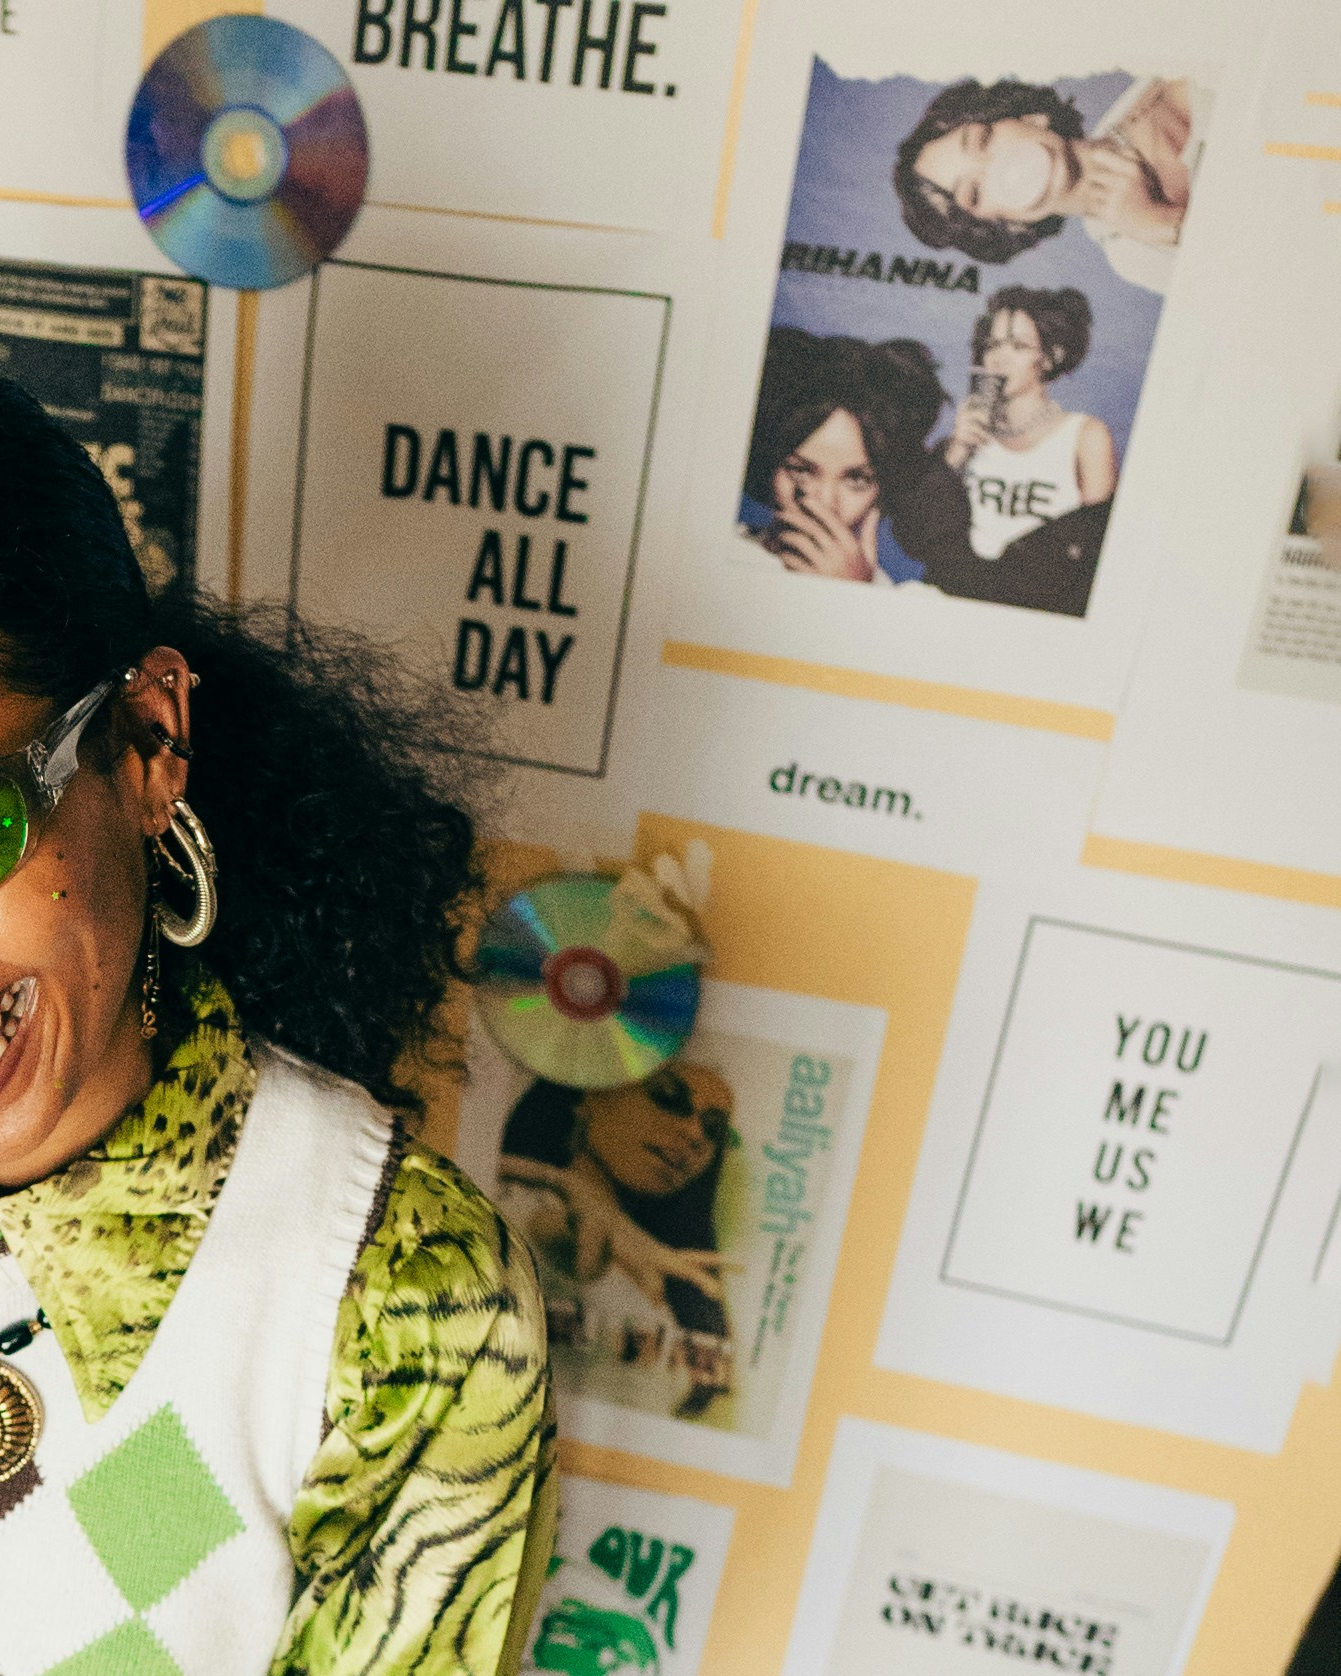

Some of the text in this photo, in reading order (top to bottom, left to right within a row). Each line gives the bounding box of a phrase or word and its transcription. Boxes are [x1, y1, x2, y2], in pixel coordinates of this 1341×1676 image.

[353, 0, 677, 97] BREATHE.
[381, 422, 595, 524] DANCE
[466, 529, 577, 617] ALL
[452, 617, 574, 705] DAY
[769, 760, 924, 822] dream.
[1115, 1013, 1208, 1074] YOU
[758, 1053, 833, 1234] aaliyah
[1103, 1080, 1180, 1135] ME
[1092, 1142, 1156, 1191] US
[1074, 1200, 1144, 1253] WE
[587, 1526, 696, 1653] OUR
